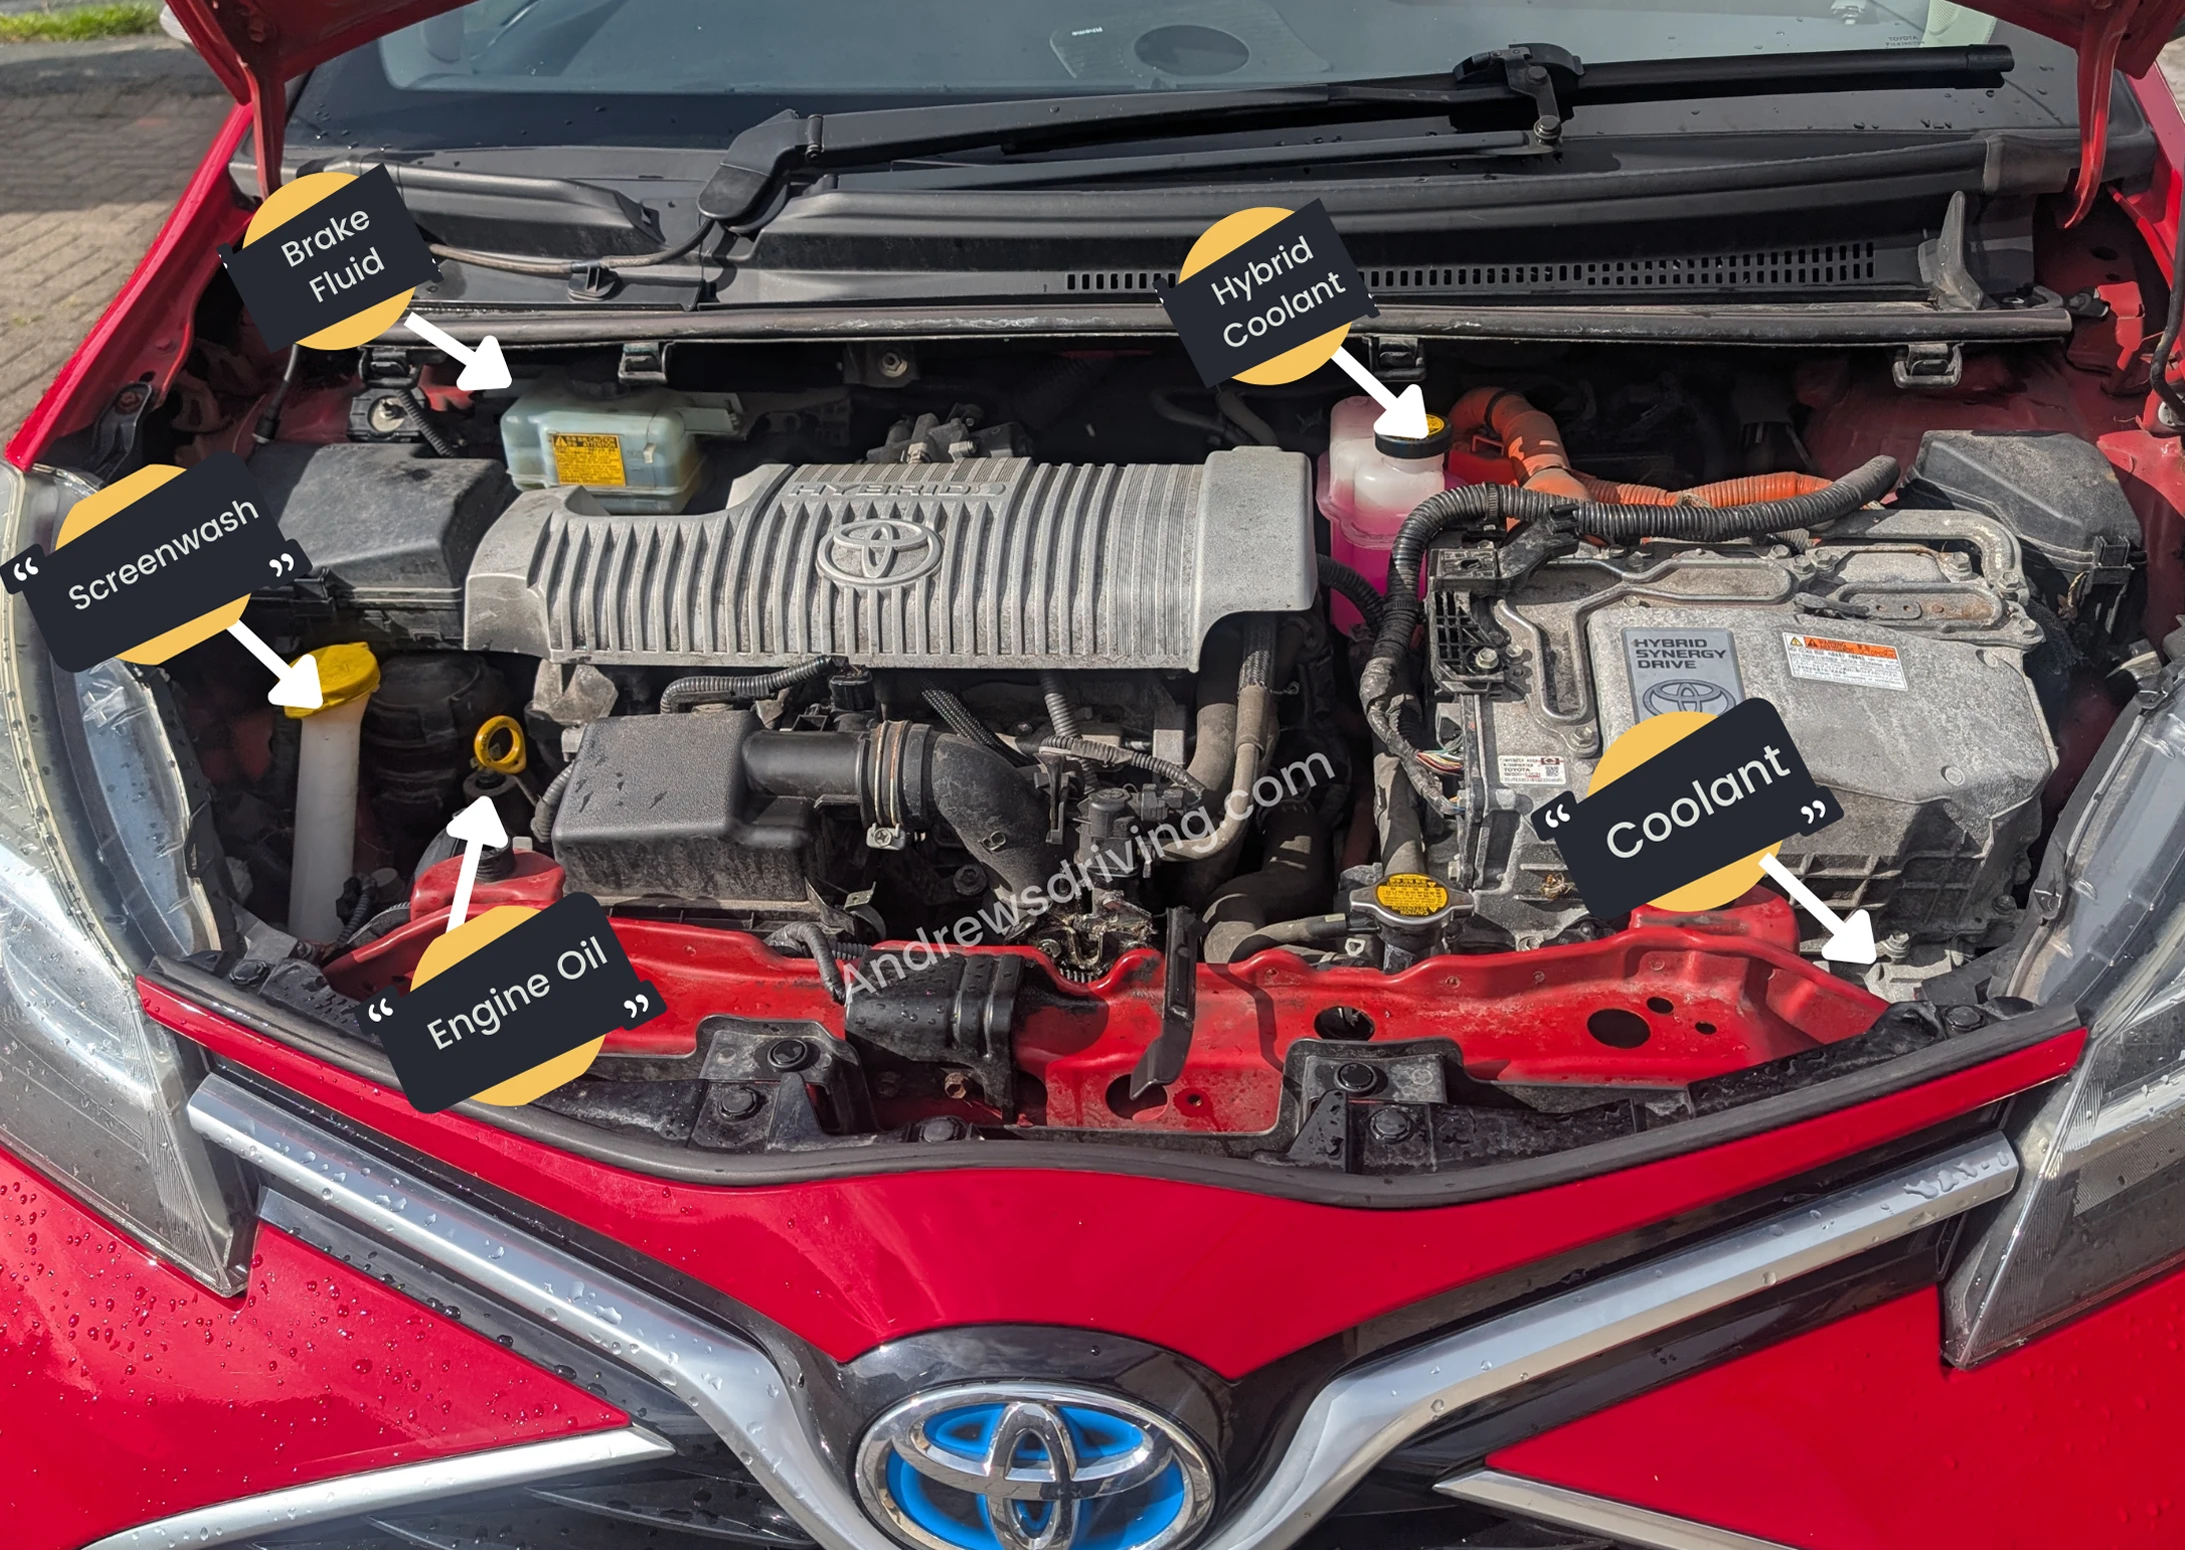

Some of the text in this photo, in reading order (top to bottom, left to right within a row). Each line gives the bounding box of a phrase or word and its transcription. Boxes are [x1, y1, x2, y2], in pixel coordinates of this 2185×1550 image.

[788, 484, 973, 496] HYBRID
[1633, 639, 1708, 648] HYBRID
[1635, 649, 1727, 658] SYNERGY
[1637, 660, 1698, 669] DRIVE
